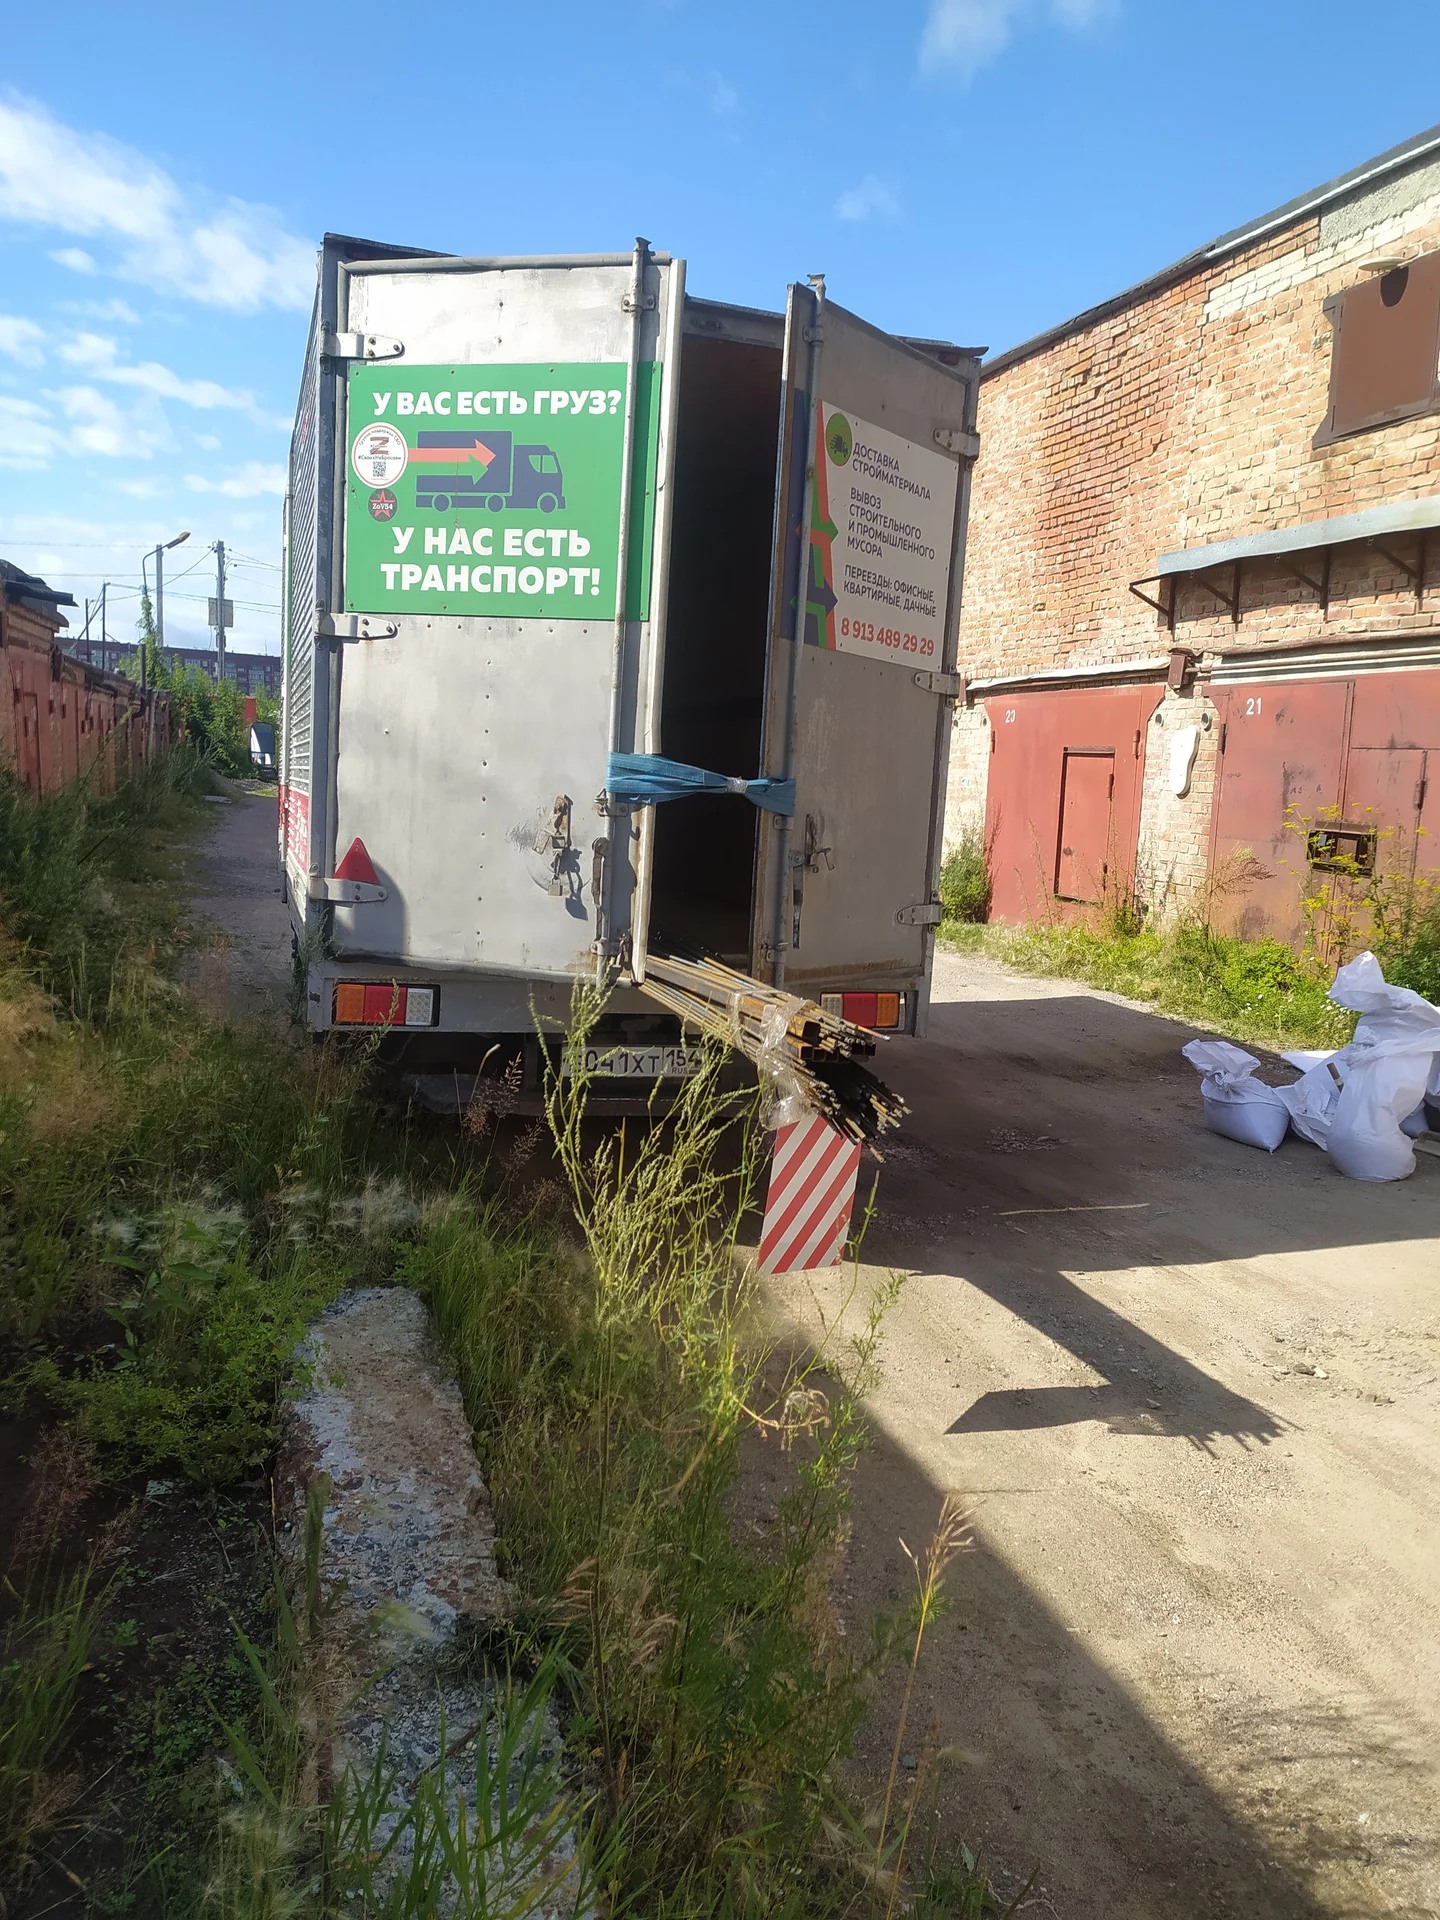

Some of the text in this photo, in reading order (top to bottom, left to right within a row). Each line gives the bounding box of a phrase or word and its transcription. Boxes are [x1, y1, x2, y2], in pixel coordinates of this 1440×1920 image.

[372, 389, 622, 416] У ВАС ЕСТЬ ГРУЗ?
[853, 442, 900, 472] ДОСТАВКА
[852, 459, 931, 501] СТРОЙМАТЕРИАЛА
[850, 487, 882, 510] ВЫВОЗ
[849, 504, 922, 540] СТРОИТЕЛЬНОГО
[391, 527, 591, 557] У НАС ЕСТЬ
[847, 536, 883, 559] МУСОРА
[848, 520, 935, 560] И ПРОМЫШЛЕННОГО
[380, 563, 601, 596] ТРАНСПОРТ!
[844, 564, 935, 604] ПЕРЕЕЗДЫ: ОФИСНЫЕ,
[843, 580, 936, 618] КВАРТИРНЫЕ, ДАЧНЫЕ
[841, 617, 935, 657] 8 913 489 29 29
[1005, 709, 1016, 723] 23
[1246, 698, 1263, 715] 21
